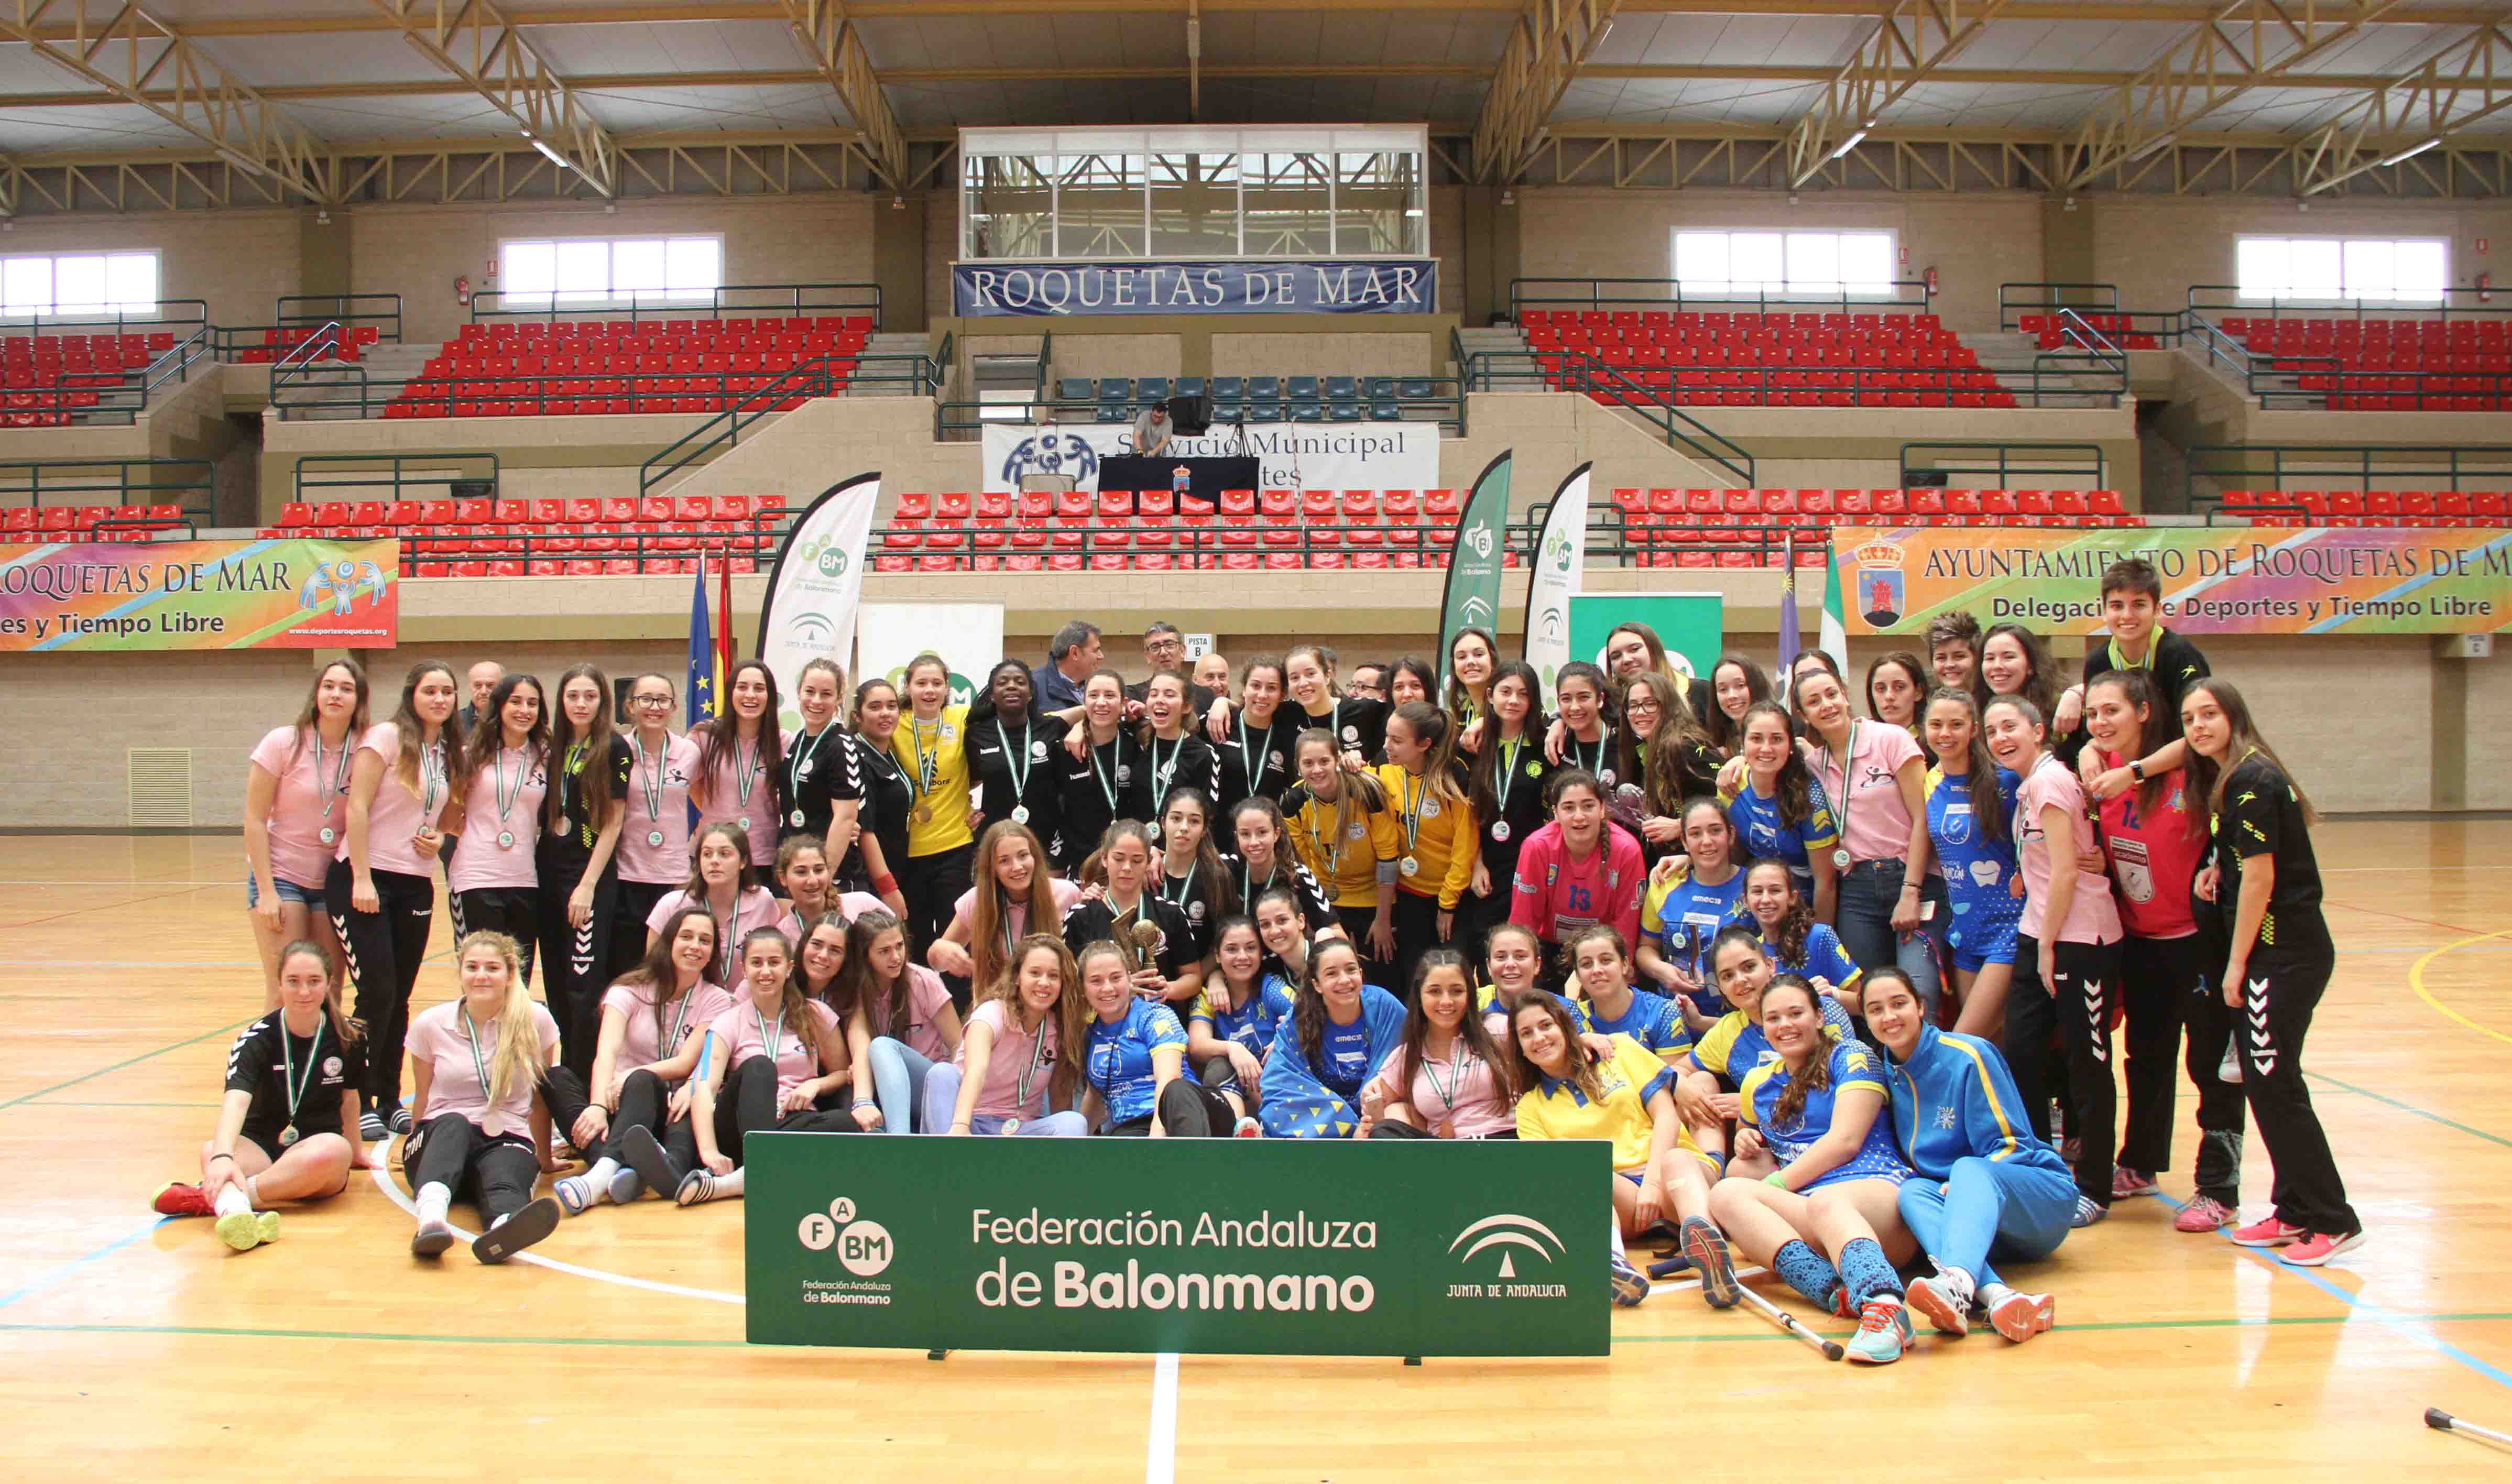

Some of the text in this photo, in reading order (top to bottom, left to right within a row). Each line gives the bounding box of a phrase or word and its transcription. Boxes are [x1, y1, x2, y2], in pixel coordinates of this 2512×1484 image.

[972, 267, 1421, 314] ROQUETAS DE MAR
[1117, 431, 1405, 462] Svicio Municipal
[821, 553, 846, 571] BM
[2197, 549, 2237, 576] DE
[2253, 544, 2417, 584] ROQUETAS
[2431, 549, 2469, 576] DE
[0, 558, 293, 602] OQUETAS DE MAR
[1993, 597, 2102, 623] Delegaci
[2185, 598, 2298, 621] Deportes
[2307, 602, 2320, 621] y
[2330, 597, 2421, 620] Tiempo
[2431, 596, 2491, 616] Libre
[35, 618, 50, 639] y
[58, 613, 151, 638] Tiempo
[161, 612, 224, 632] Libre
[289, 628, 387, 636] www.deportesroquetas.org
[1195, 647, 1201, 657] B
[1569, 884, 1591, 912] 13
[837, 1201, 849, 1217] A
[812, 1221, 824, 1242] F
[973, 1207, 1377, 1248] Federación Andaluza
[845, 1235, 886, 1261] BM
[802, 1279, 891, 1291] Federación Andaluza
[976, 1256, 1375, 1312] de Balonmano
[1446, 1284, 1567, 1297] JUNTA DE ANDALUCIA
[803, 1291, 891, 1304] de Balonmano
